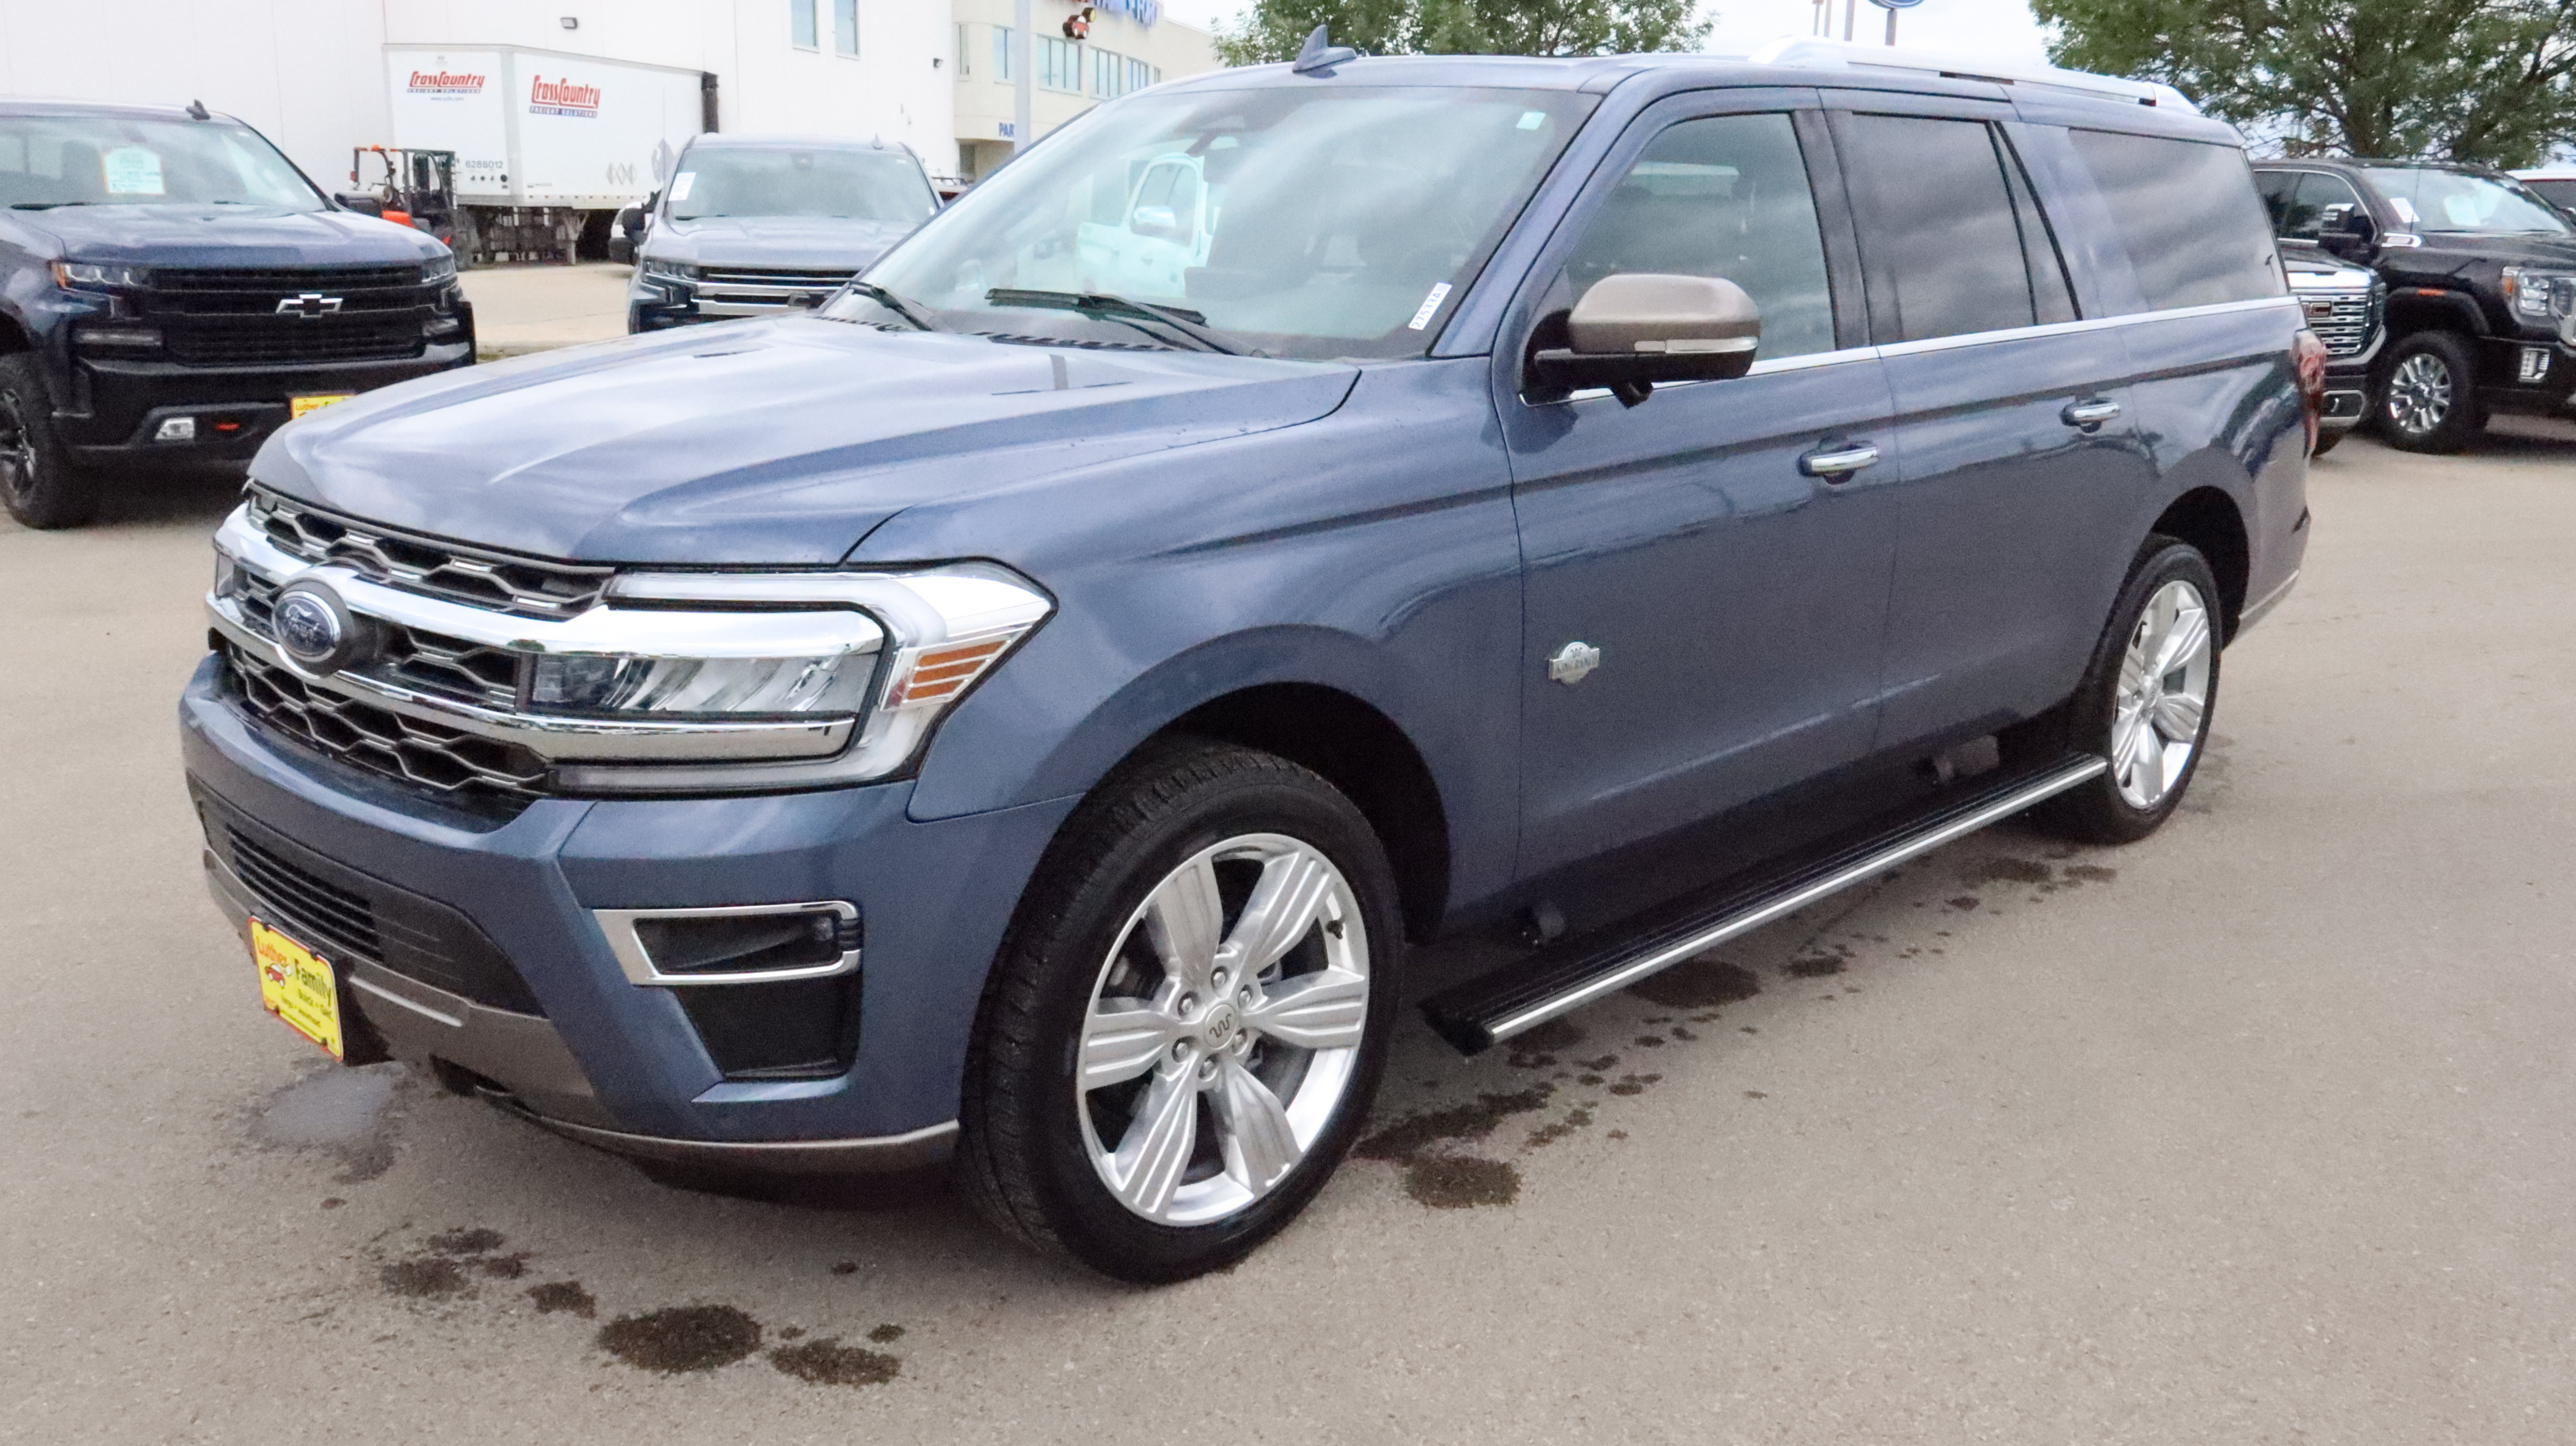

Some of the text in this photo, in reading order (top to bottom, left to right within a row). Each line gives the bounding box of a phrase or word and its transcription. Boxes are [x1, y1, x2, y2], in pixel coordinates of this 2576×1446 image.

[409, 71, 485, 88] CrossCountry
[531, 74, 601, 109] CrossCountry
[294, 958, 332, 1007] Family
